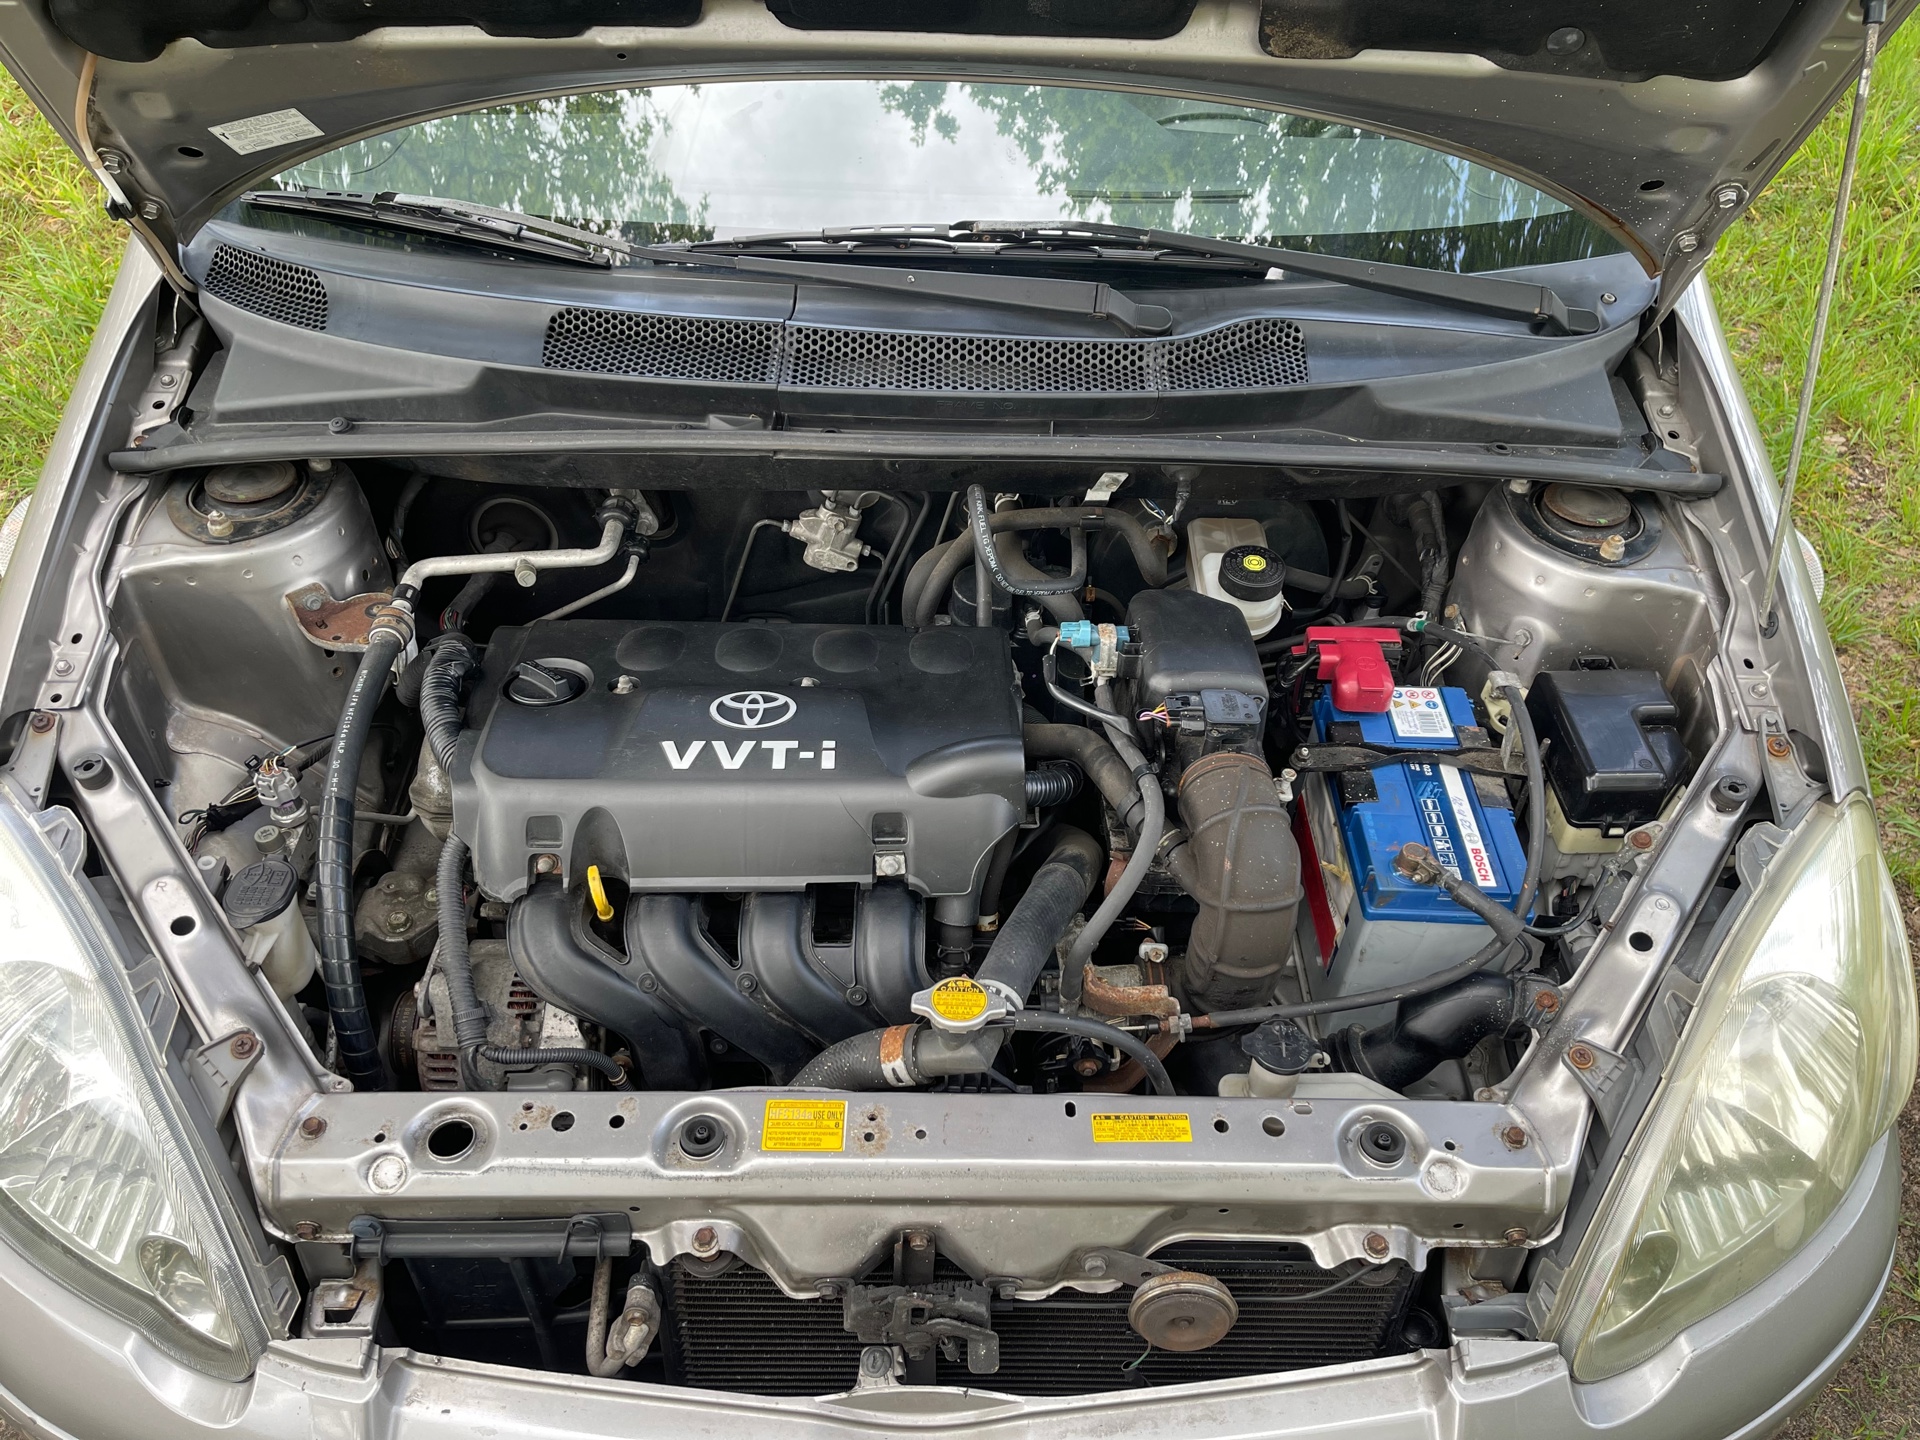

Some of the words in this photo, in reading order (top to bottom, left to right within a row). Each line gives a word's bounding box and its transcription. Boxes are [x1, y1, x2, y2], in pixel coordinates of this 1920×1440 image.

[978, 515, 987, 533] FUEL
[660, 740, 837, 770] VVT-i
[1470, 847, 1491, 882] BOSCH
[402, 1007, 411, 1023] 1180
[399, 1025, 407, 1038] PK
[769, 1108, 813, 1120] HFC134a
[813, 1110, 826, 1120] USE
[826, 1110, 844, 1120] ONLY
